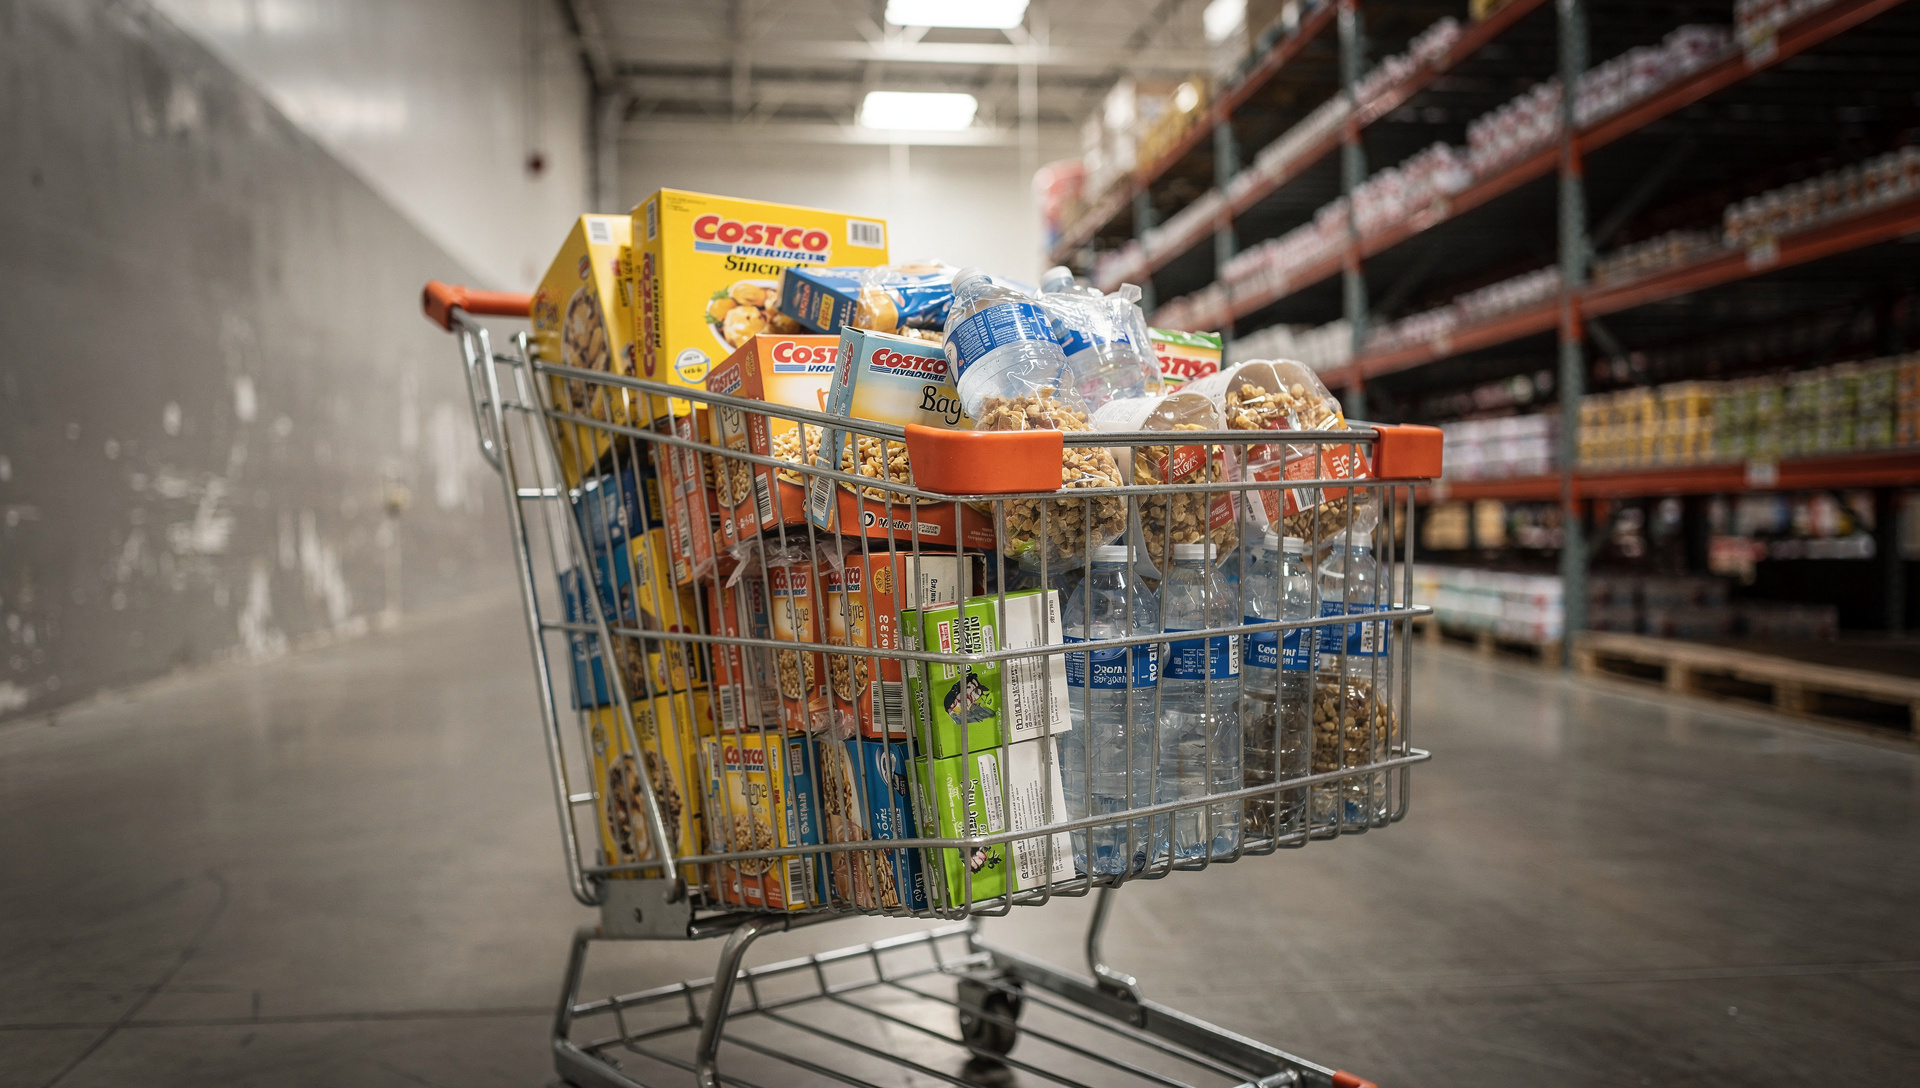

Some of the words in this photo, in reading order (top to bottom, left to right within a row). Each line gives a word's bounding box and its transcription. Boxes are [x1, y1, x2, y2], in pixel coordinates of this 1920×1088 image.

[694, 215, 829, 252] COSTCO
[871, 348, 949, 374] COSTCO
[919, 385, 969, 425] Bay
